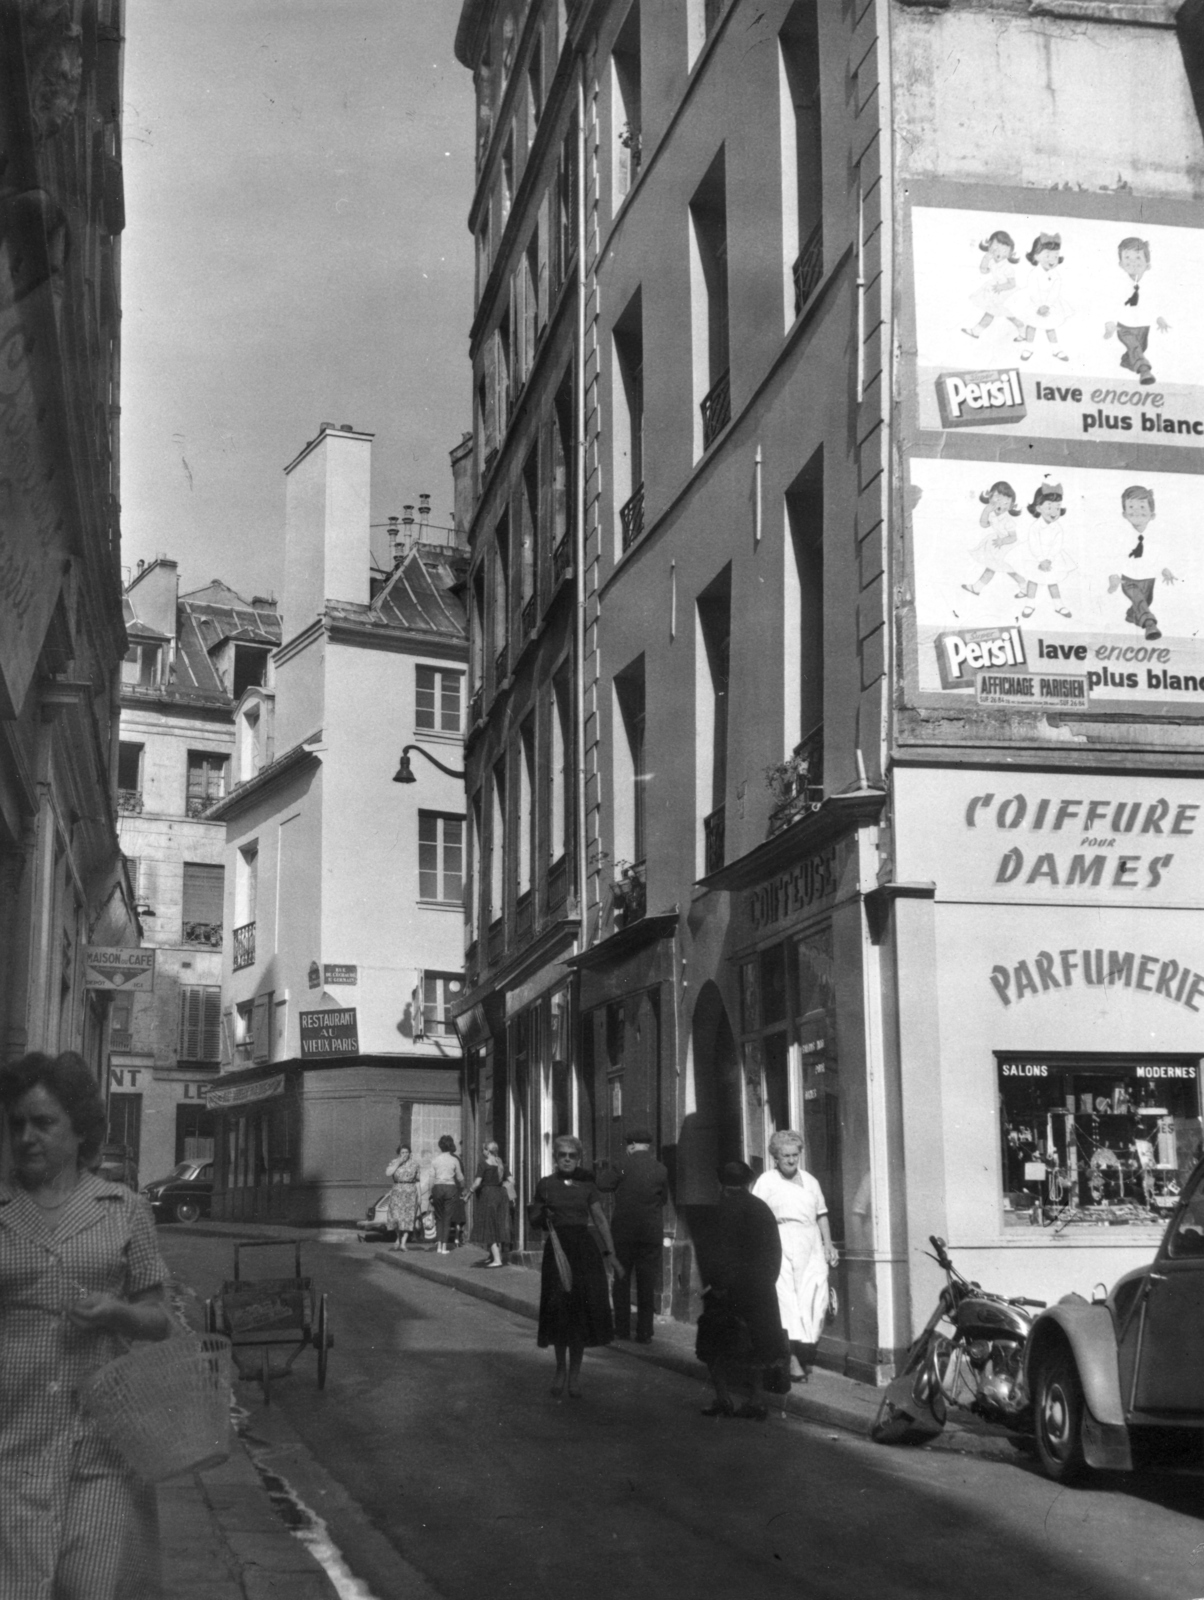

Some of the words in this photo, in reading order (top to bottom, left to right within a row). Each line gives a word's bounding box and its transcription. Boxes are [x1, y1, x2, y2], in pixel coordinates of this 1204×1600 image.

[945, 370, 1023, 417] Persil
[1036, 381, 1083, 403] lave
[1090, 388, 1165, 408] encore
[1082, 409, 1133, 433] plus
[1141, 412, 1204, 435] blanc
[944, 628, 1025, 677] Persil
[1038, 639, 1088, 660] lave
[1095, 644, 1171, 664] encore
[981, 675, 1035, 697] AFFICHAGE
[1040, 678, 1085, 699] PARISIEN
[1087, 666, 1138, 690] plus
[965, 793, 1201, 835] COIFFURE
[1080, 836, 1116, 847] POUR
[995, 846, 1175, 889] DAMES
[86, 951, 121, 964] MAISON
[989, 948, 1204, 1013] PARFUMERIE
[302, 1011, 354, 1028] RESTAURANT
[320, 1028, 337, 1037] AU
[302, 1039, 330, 1053] VIEUX
[331, 1037, 358, 1052] PARIS
[1002, 1064, 1048, 1077] SALONS
[1136, 1066, 1196, 1079] MODERNES
